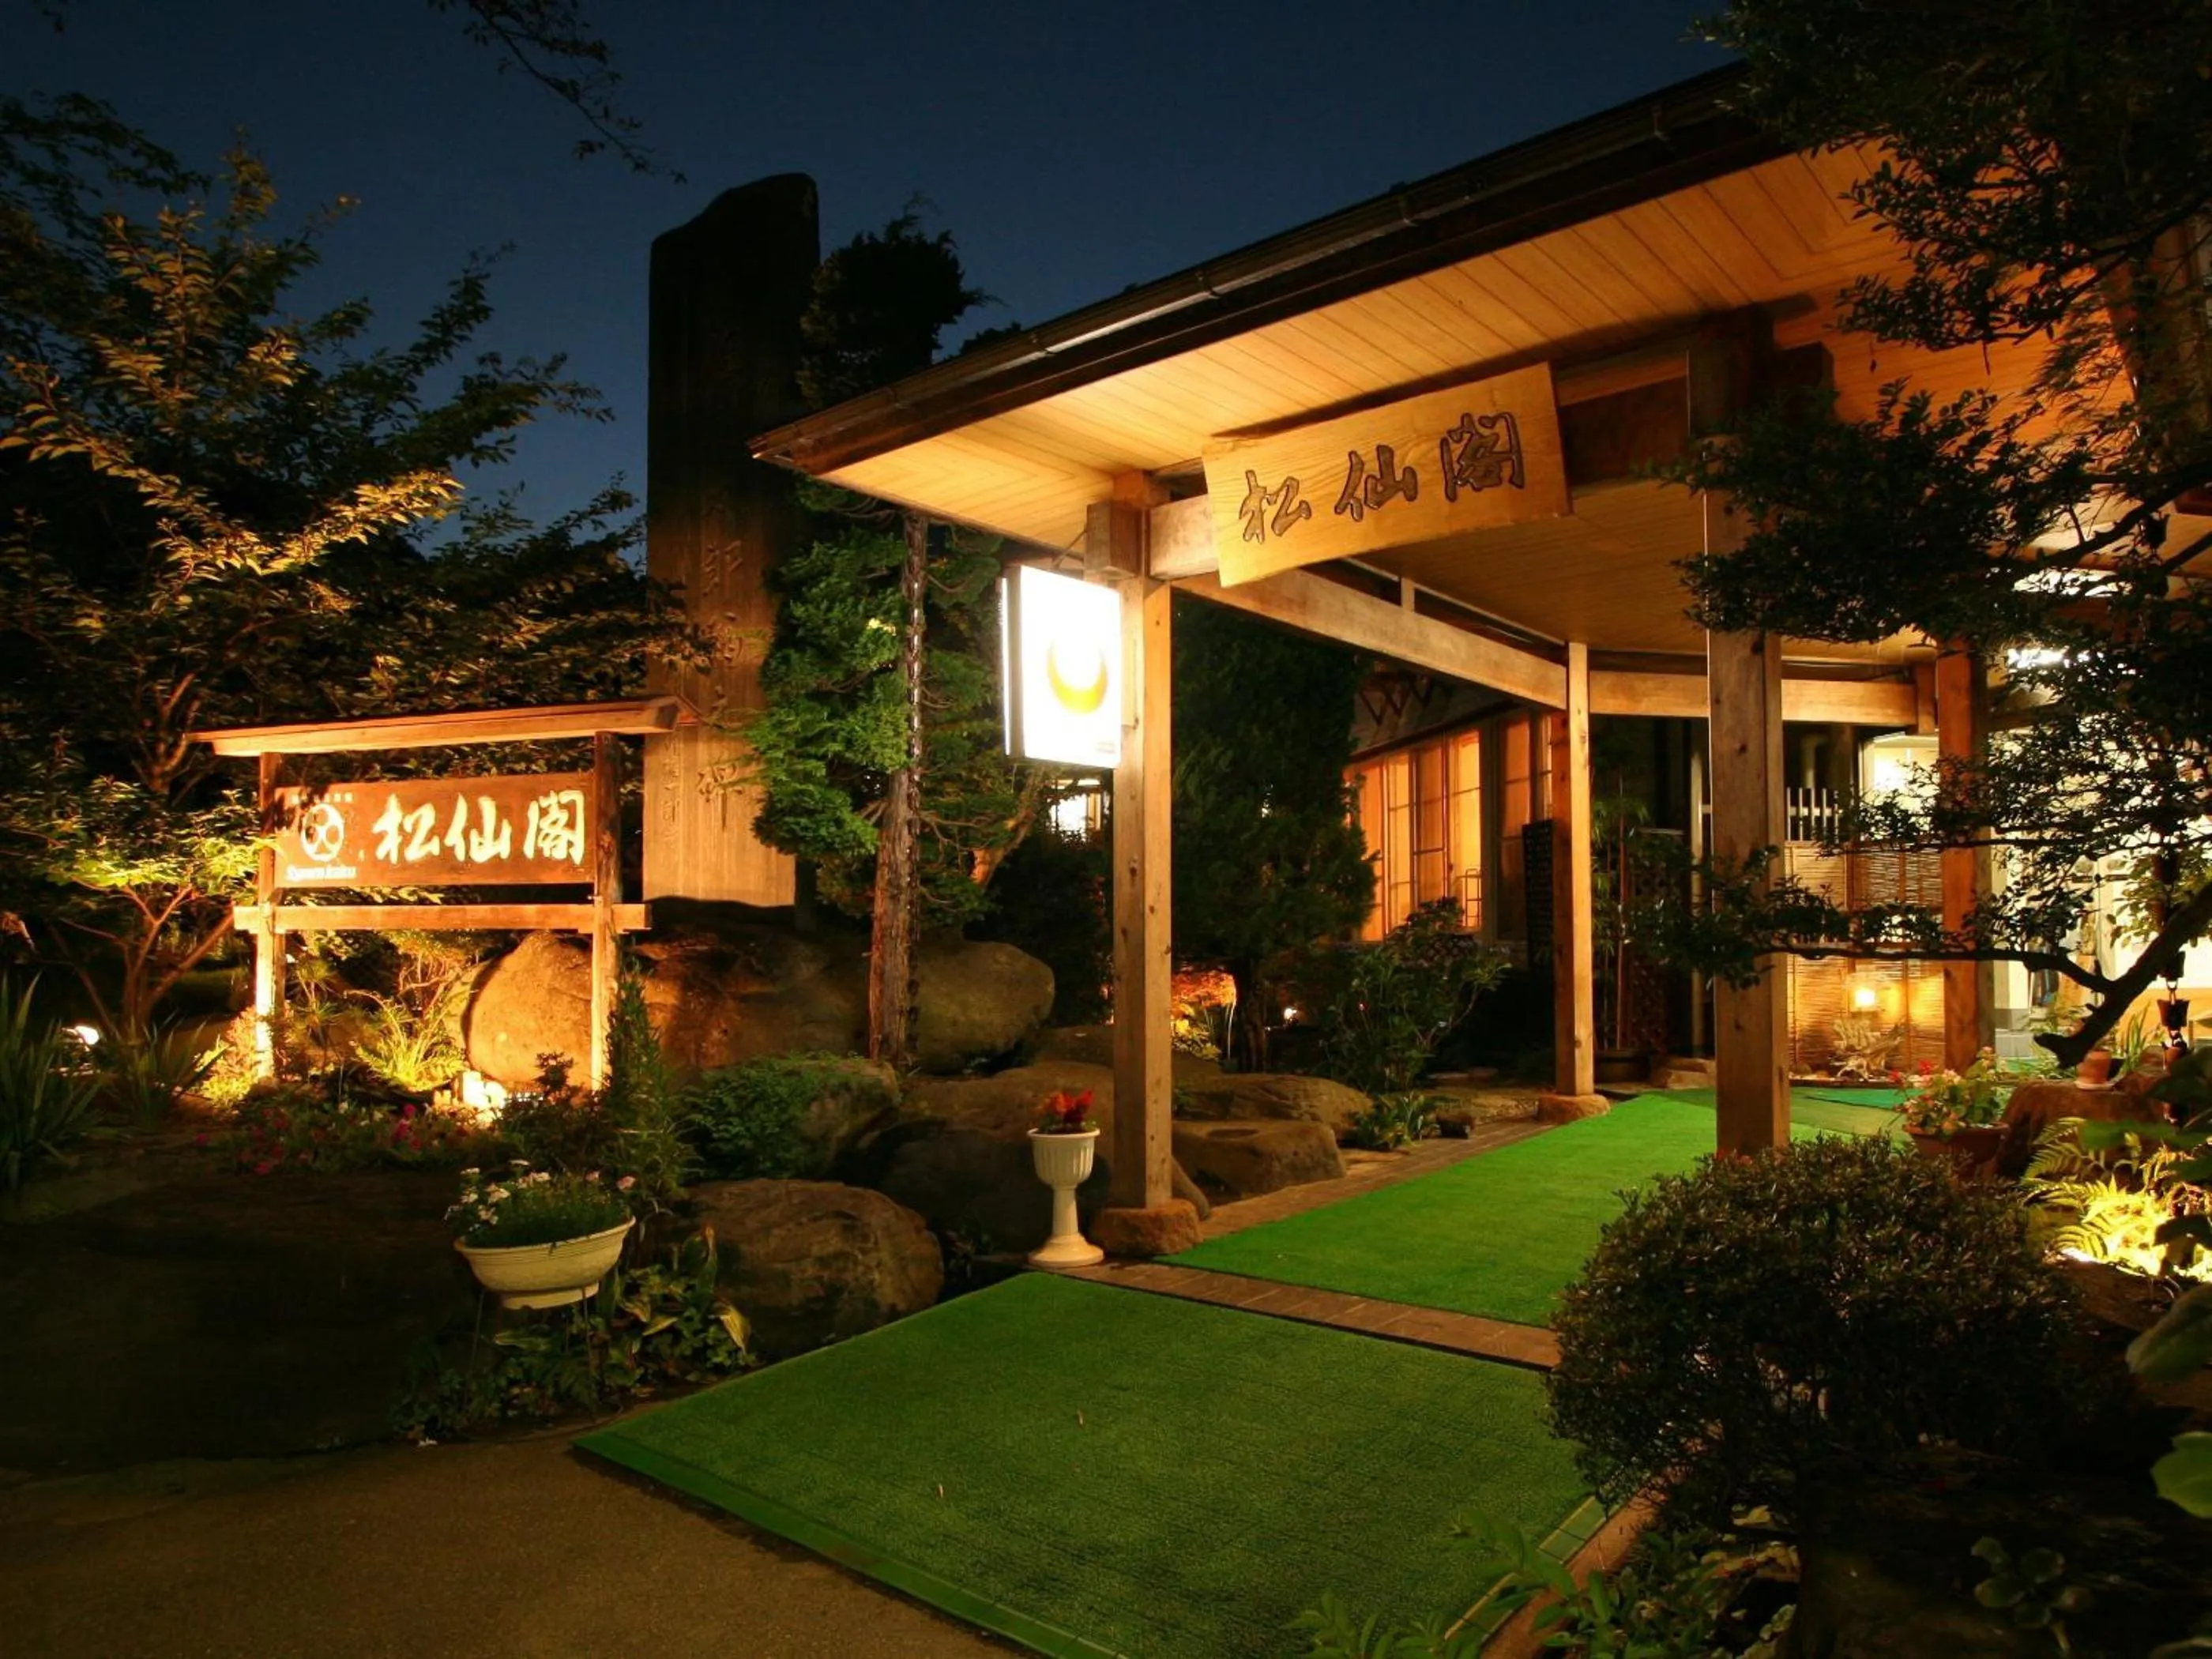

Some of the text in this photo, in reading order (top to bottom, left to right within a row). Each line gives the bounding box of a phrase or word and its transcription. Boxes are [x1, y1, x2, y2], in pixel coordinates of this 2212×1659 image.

[1239, 412, 1525, 544] 松仙閣
[372, 790, 585, 866] 松仙閣
